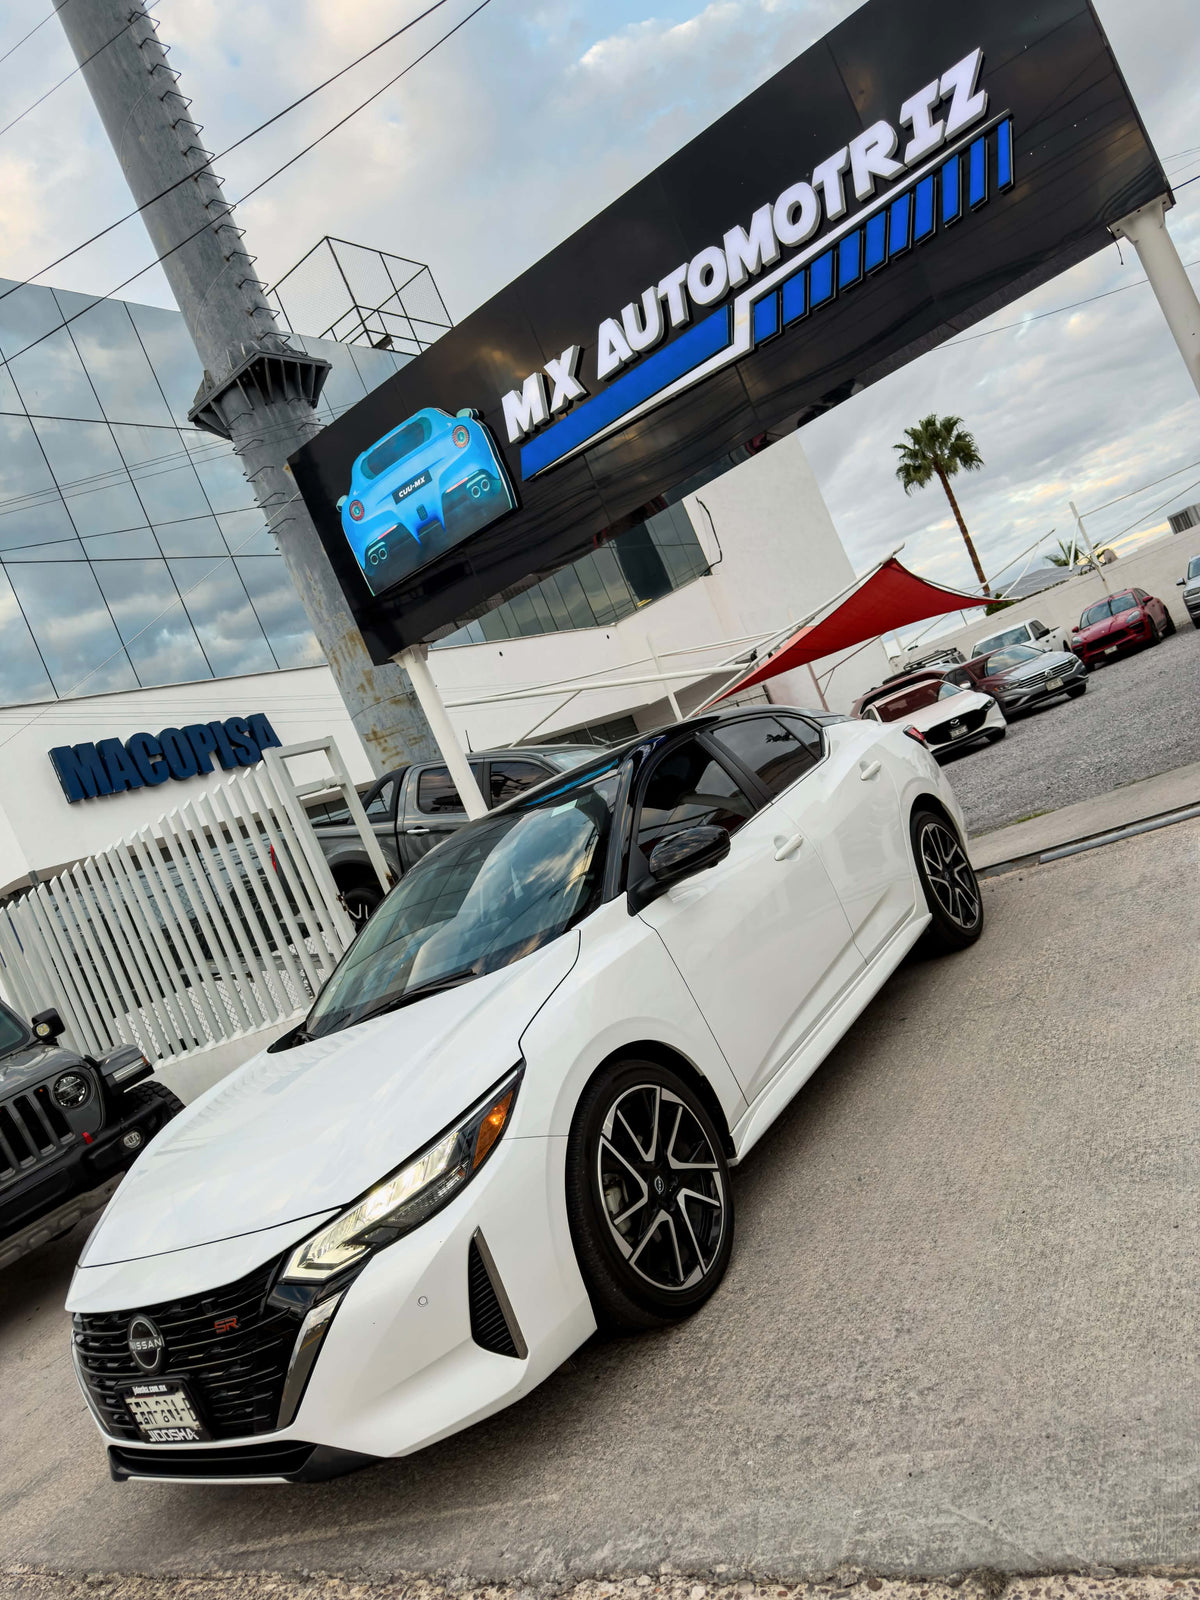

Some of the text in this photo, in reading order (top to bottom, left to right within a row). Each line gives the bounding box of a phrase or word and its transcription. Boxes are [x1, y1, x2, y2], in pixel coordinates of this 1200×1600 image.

[502, 47, 988, 444] MX AUTOMOTRIZ
[398, 476, 426, 498] CUU-MX
[48, 712, 283, 804] MACOPISA
[214, 1315, 240, 1334] SR
[128, 1337, 163, 1351] NISSAN
[147, 1428, 200, 1442] JIDOSHA
